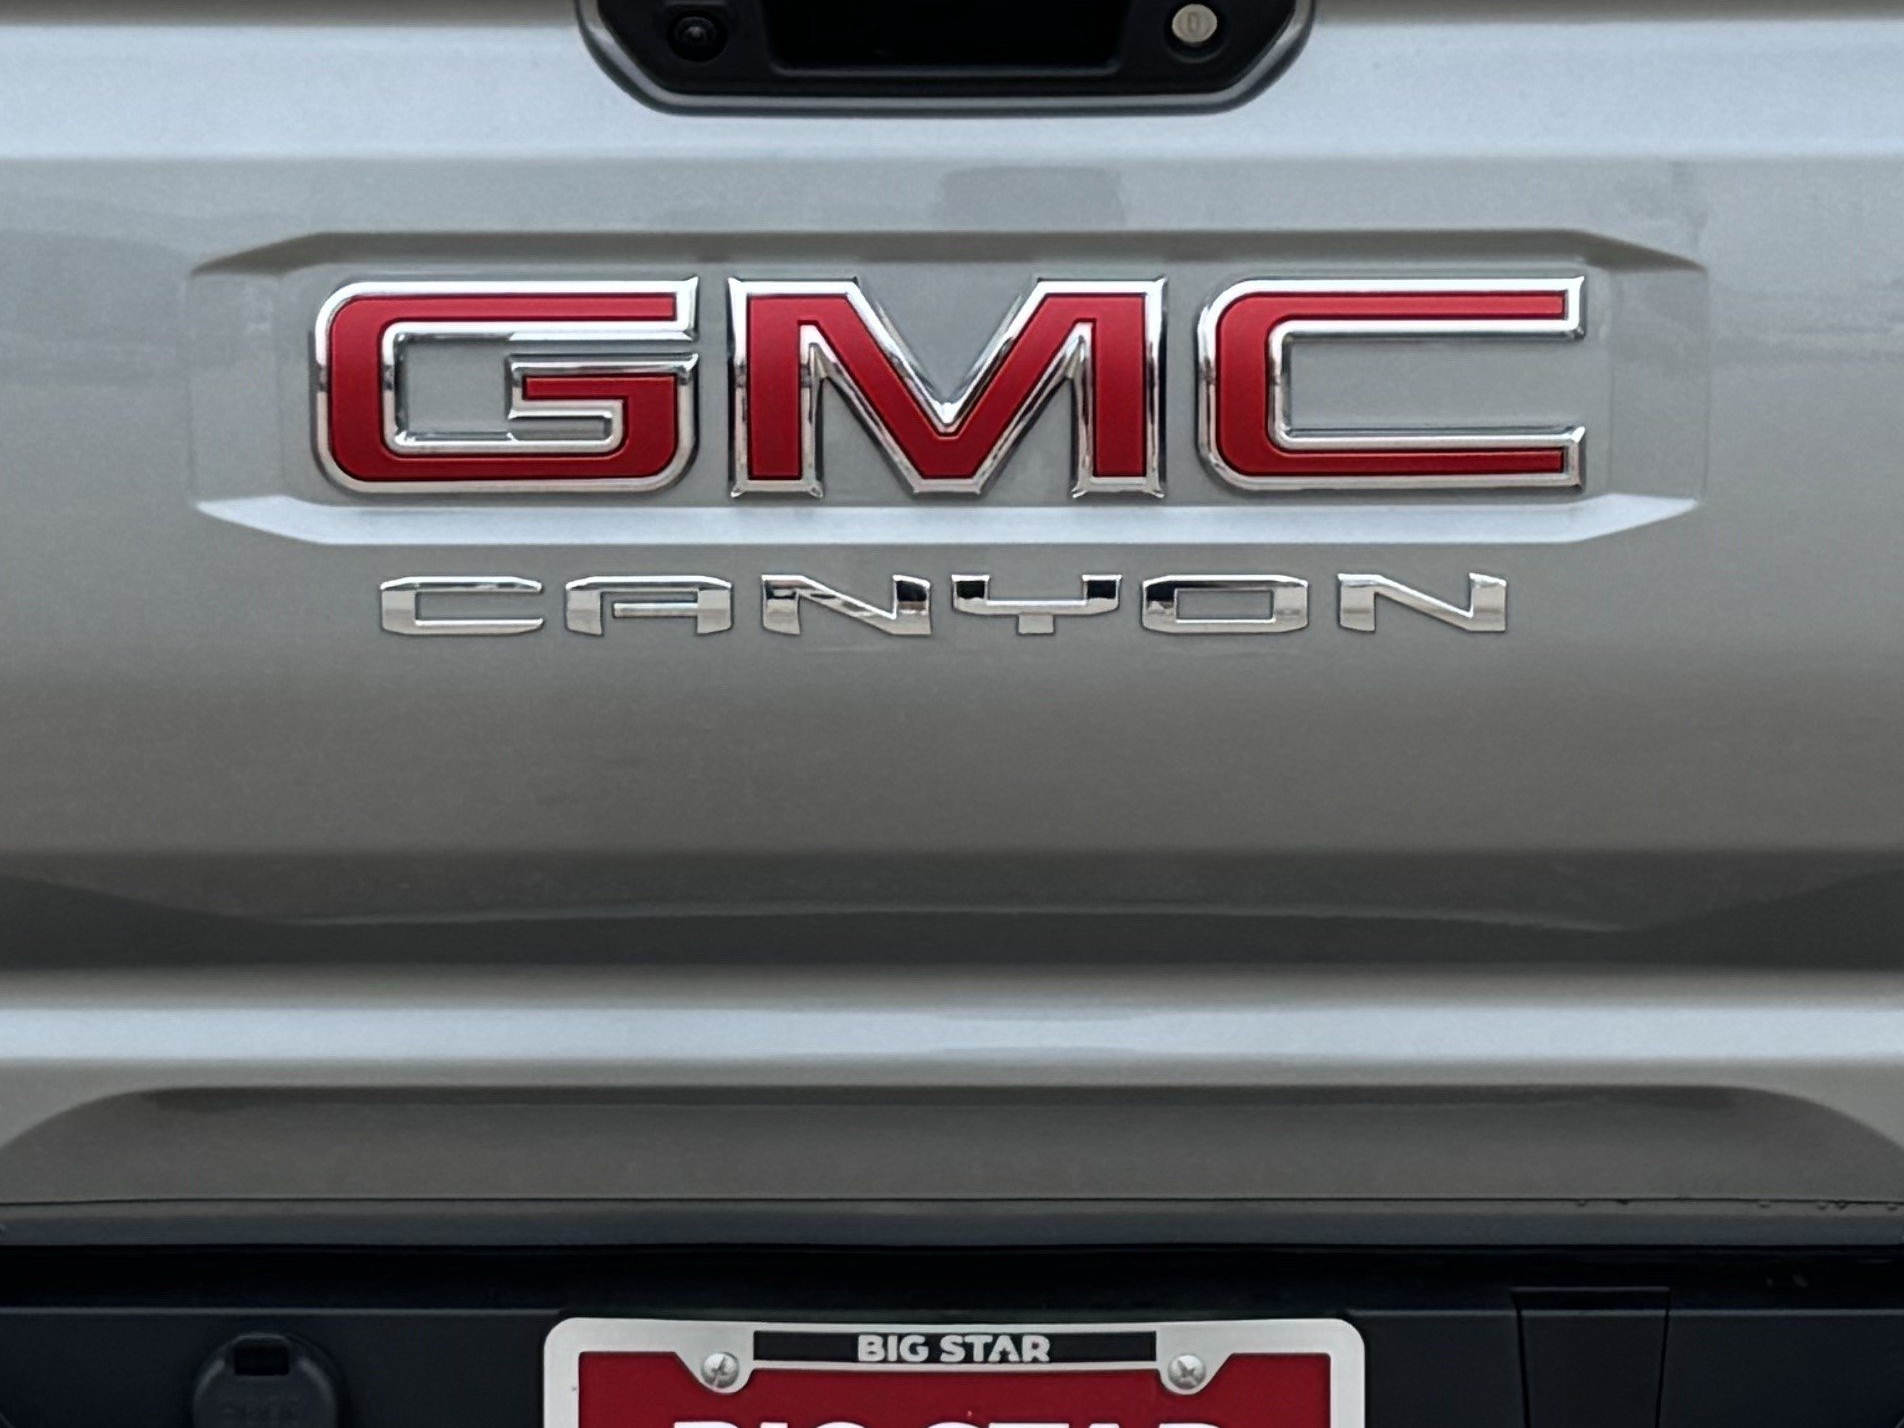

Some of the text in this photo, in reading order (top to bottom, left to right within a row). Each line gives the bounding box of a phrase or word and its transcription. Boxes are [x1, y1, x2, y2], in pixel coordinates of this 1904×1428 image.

[314, 275, 1587, 499] GMC
[379, 571, 1508, 636] CANYON
[857, 1333, 1050, 1363] BIG STAR
